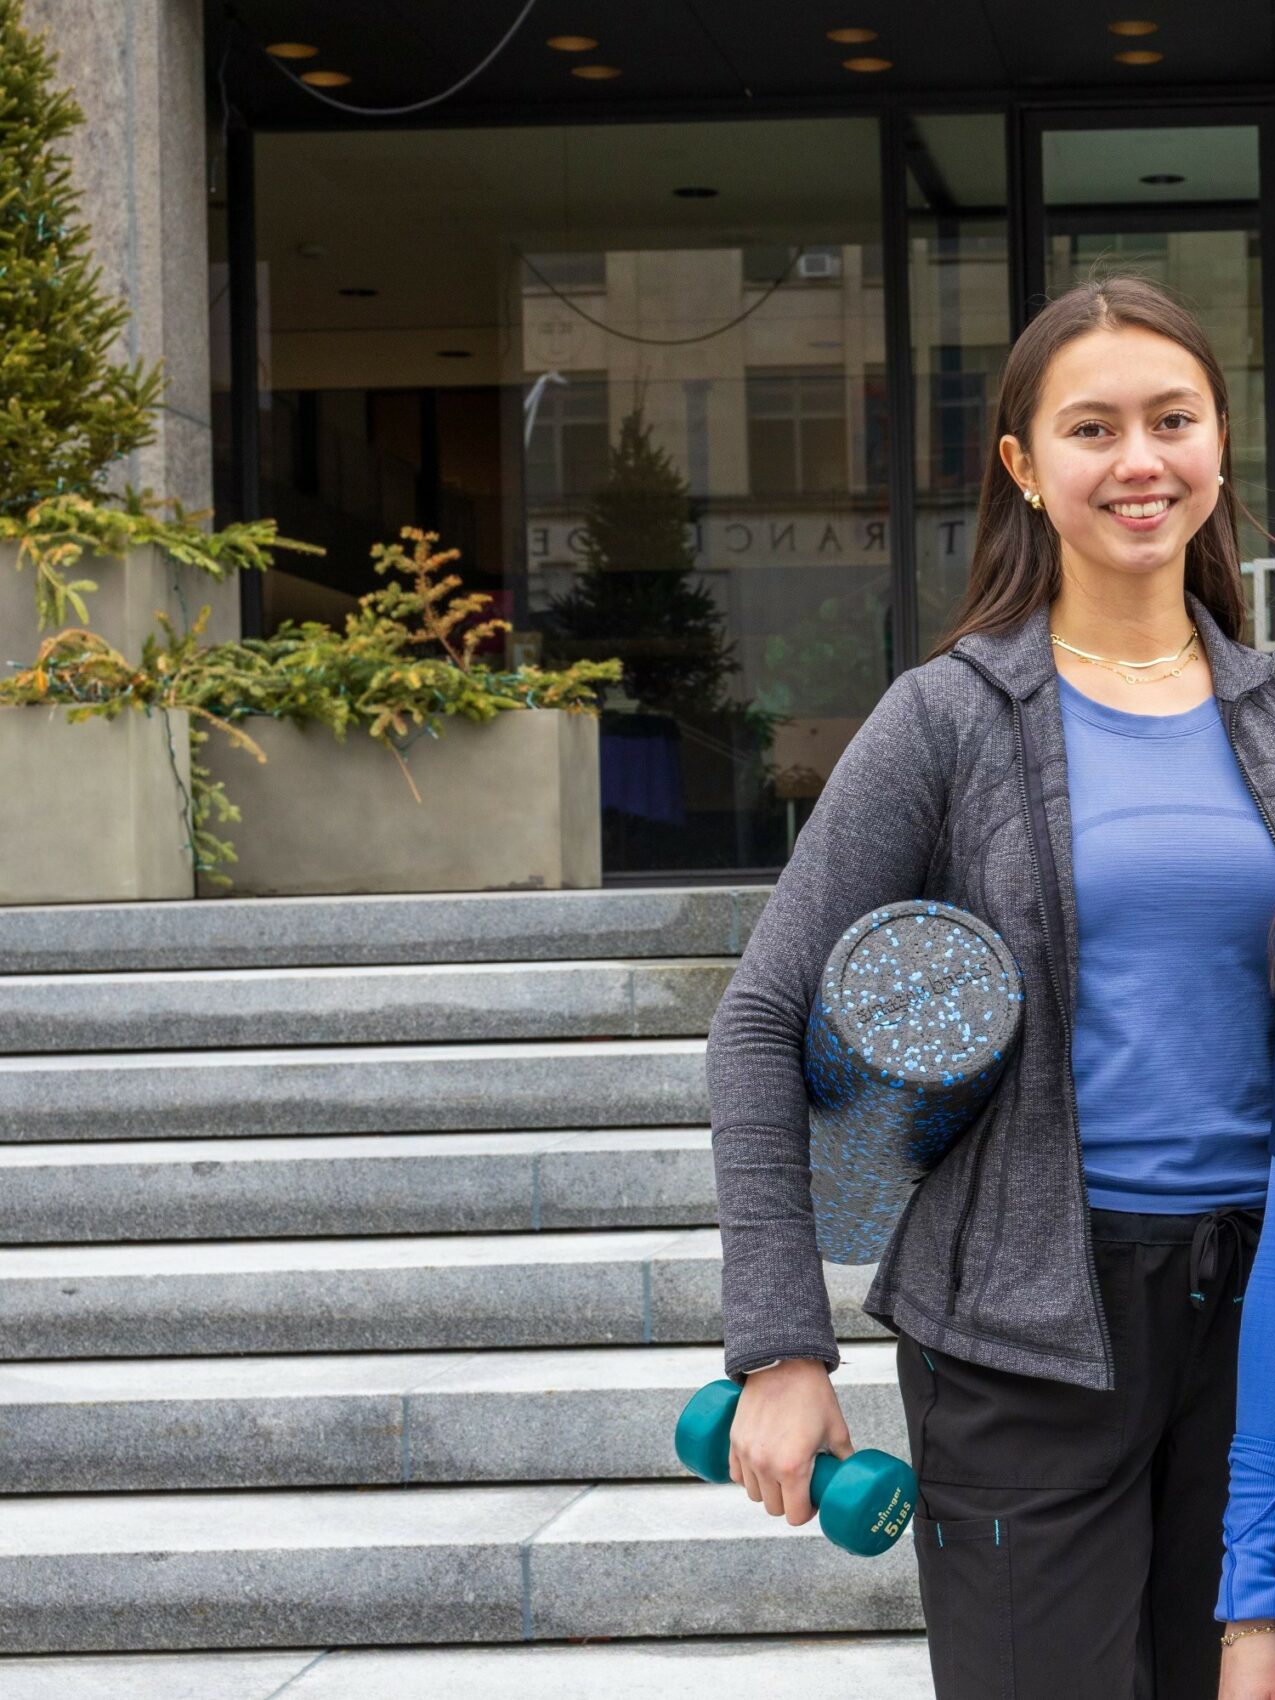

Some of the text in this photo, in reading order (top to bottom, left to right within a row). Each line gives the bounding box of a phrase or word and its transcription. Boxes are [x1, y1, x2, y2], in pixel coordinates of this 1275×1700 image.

[870, 1487, 902, 1533] Bollinger
[883, 1501, 911, 1537] 5 LBS
